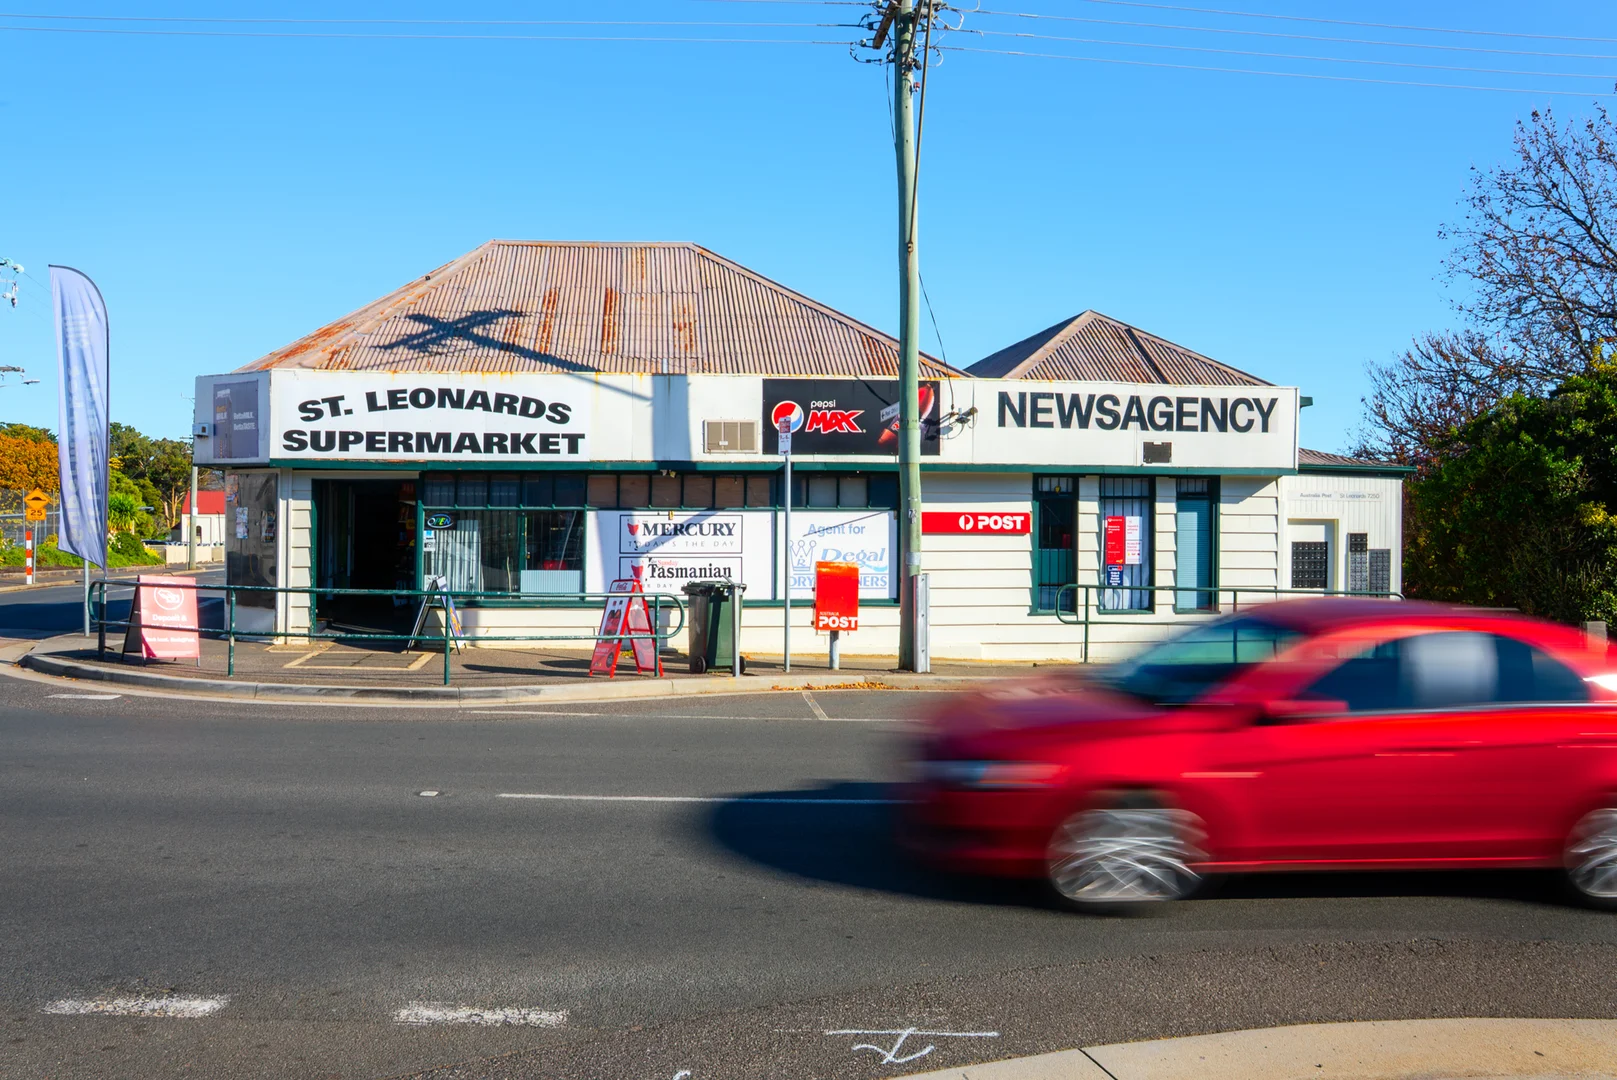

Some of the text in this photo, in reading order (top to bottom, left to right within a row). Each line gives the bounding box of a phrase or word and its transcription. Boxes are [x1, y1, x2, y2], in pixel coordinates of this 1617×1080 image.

[297, 387, 572, 425] ST. LEONARDS
[810, 399, 836, 409] pepsi
[997, 391, 1279, 433] NEWSAGENCY
[805, 409, 865, 434] MAX
[282, 429, 586, 455] SUPERMARKET
[428, 517, 450, 526] OPEN
[977, 515, 1025, 530] POST
[641, 522, 737, 537] MERCURY
[807, 523, 866, 537] Agent for
[647, 563, 733, 579] Tasmanian
[818, 616, 859, 628] POST
